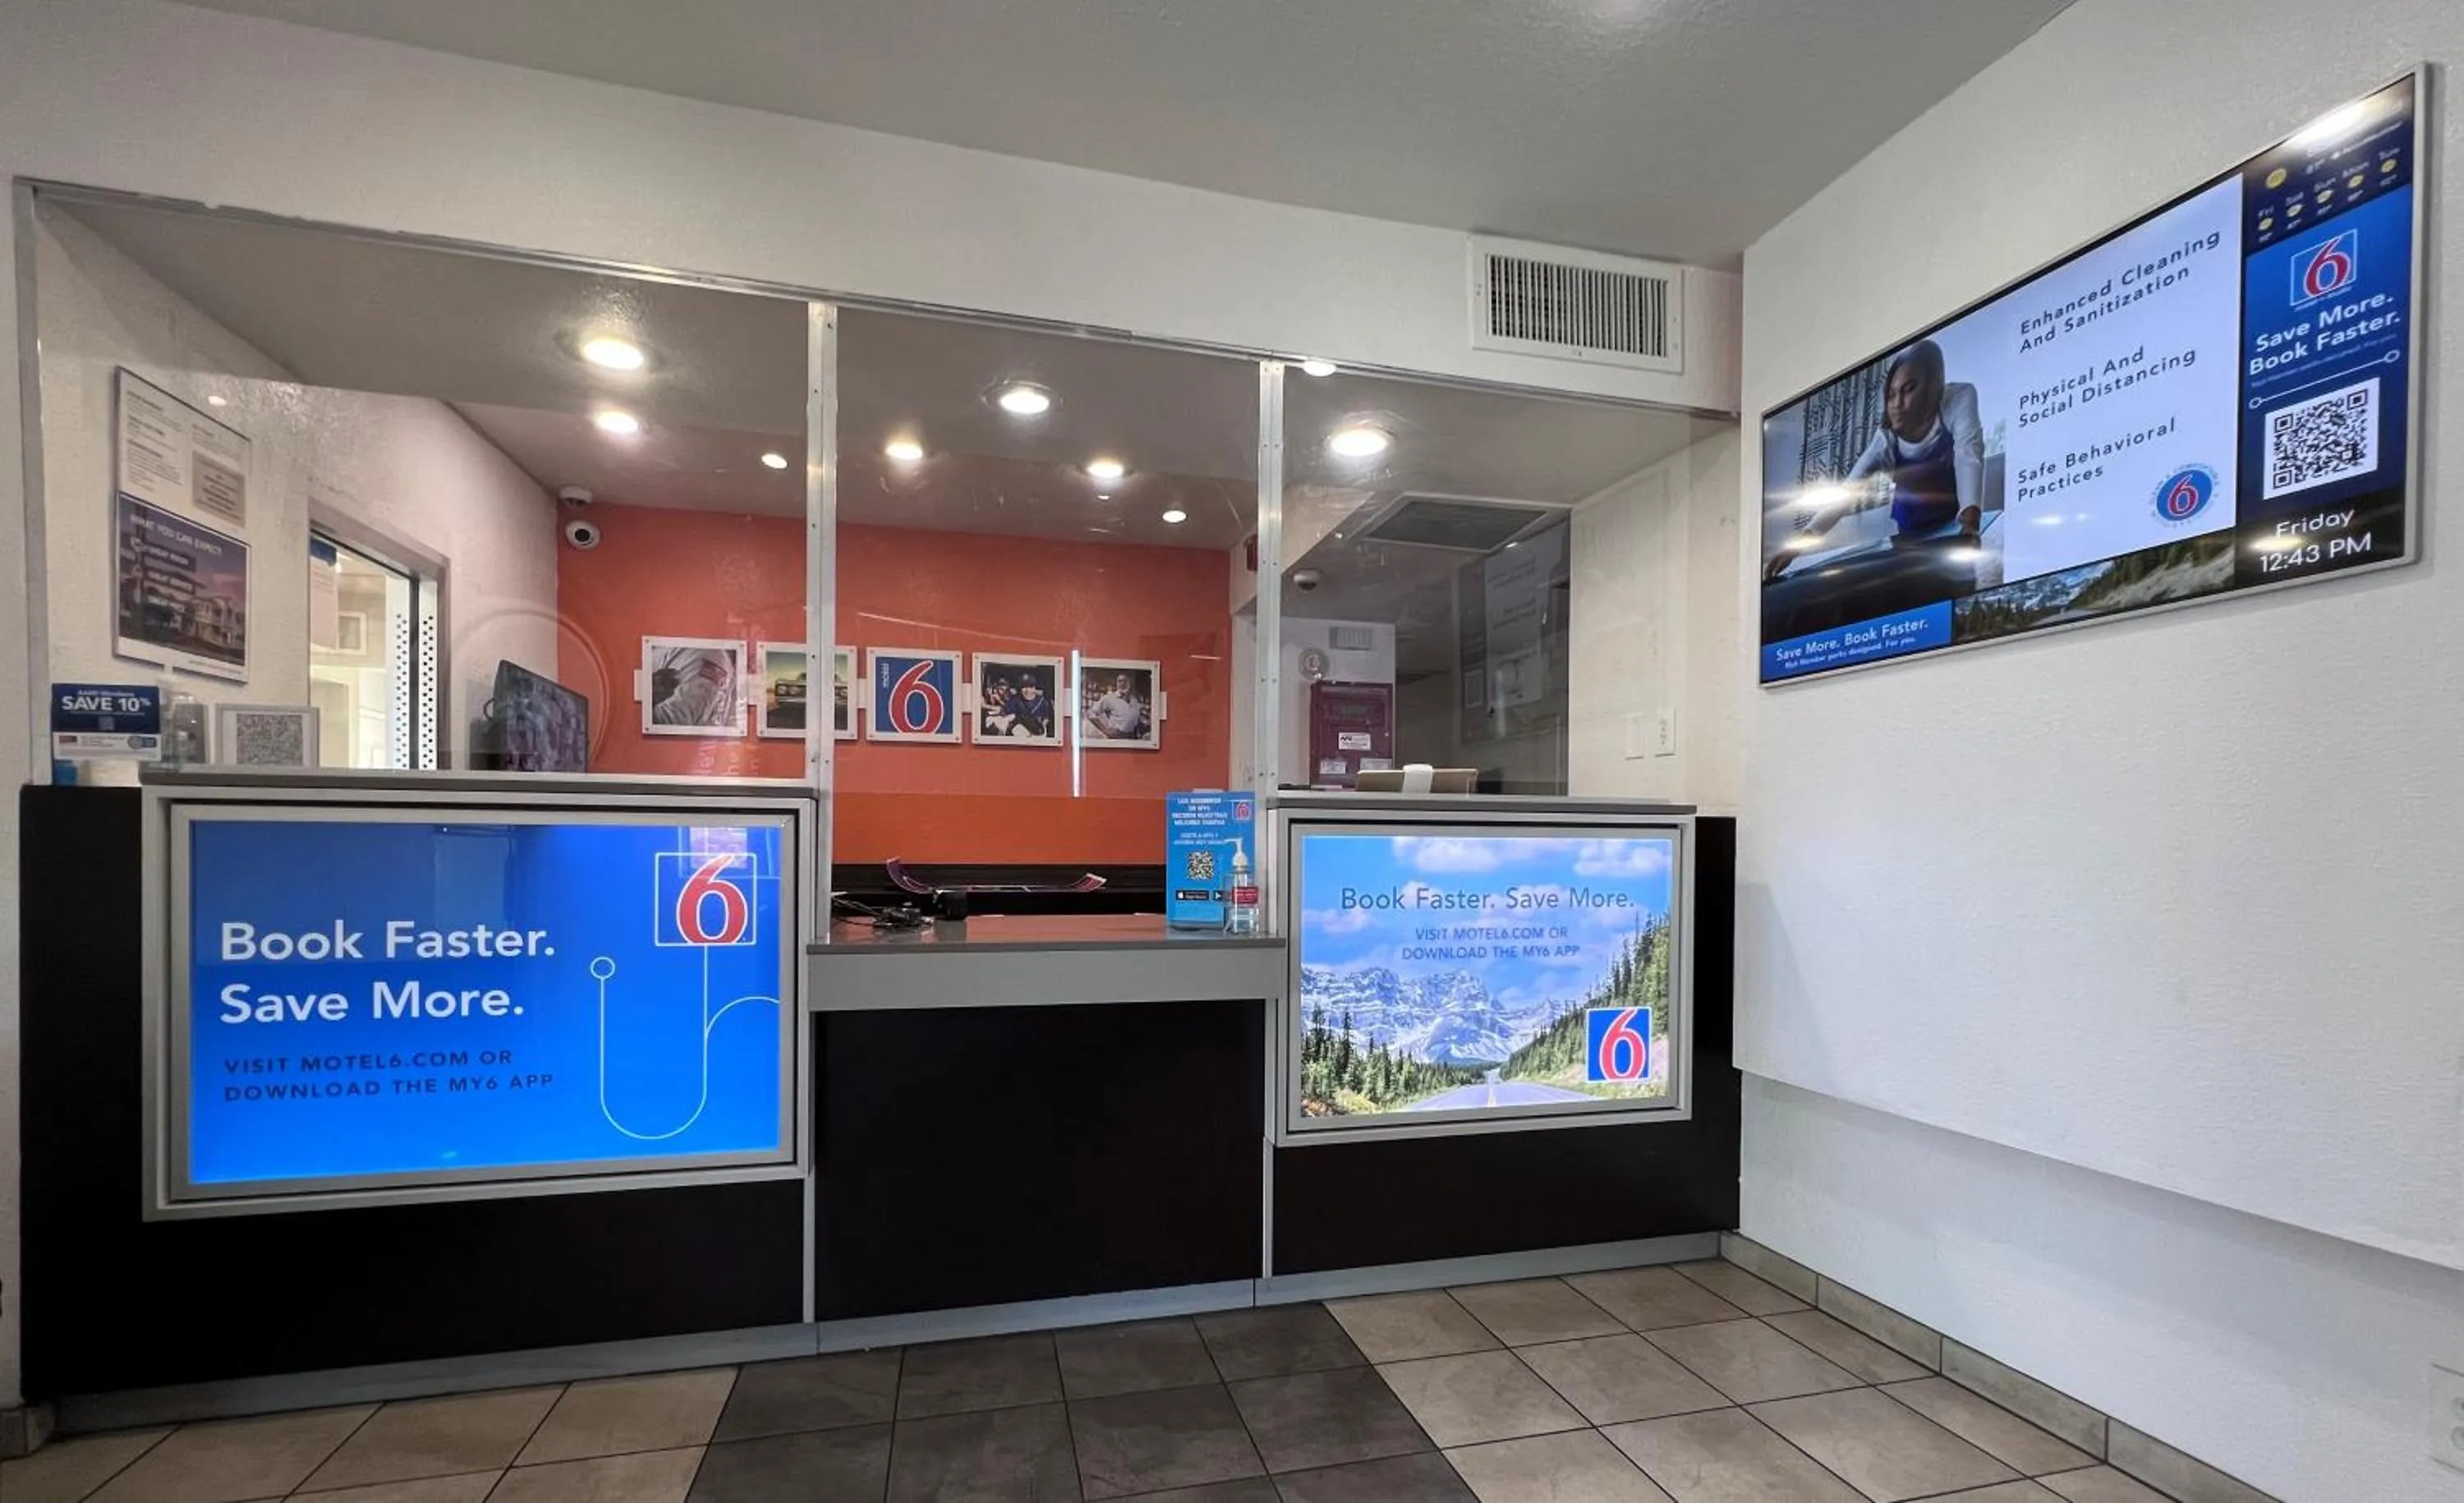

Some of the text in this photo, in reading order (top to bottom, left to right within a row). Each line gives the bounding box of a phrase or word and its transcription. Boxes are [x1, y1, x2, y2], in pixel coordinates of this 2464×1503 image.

[2020, 231, 2221, 335] Enhanced Cleaning
[2020, 268, 2190, 354] And Sanitization
[2255, 321, 2310, 352] Save
[2319, 292, 2393, 328] More.
[2249, 343, 2309, 375] Book
[2315, 313, 2401, 352] Faster.
[2019, 346, 2145, 410] Physical And
[2019, 349, 2197, 428] Social Distancing
[2018, 417, 2176, 485] Safe Behavioral
[2018, 466, 2104, 502] Practices
[2276, 509, 2356, 538] Friday
[2259, 532, 2372, 573] 12:43 PM
[1776, 618, 1928, 662] Save More. Book Faster.
[62, 695, 113, 711] SAVE
[888, 660, 945, 735] 6
[676, 853, 748, 946] 6
[1340, 886, 1634, 910] Book Faster. Save More.
[222, 919, 555, 961] Book Faster.
[1402, 945, 1580, 960] DOWNLOAD THE MY6 APP
[1415, 926, 1569, 941] VISIT MOTEL6.COM OR
[220, 980, 525, 1024] Save More.
[224, 1049, 513, 1075] VISIT MOTEL6.COM OR
[1600, 1006, 1648, 1082] 6
[224, 1073, 554, 1101] DOWNLOAD THE MY6 APP
